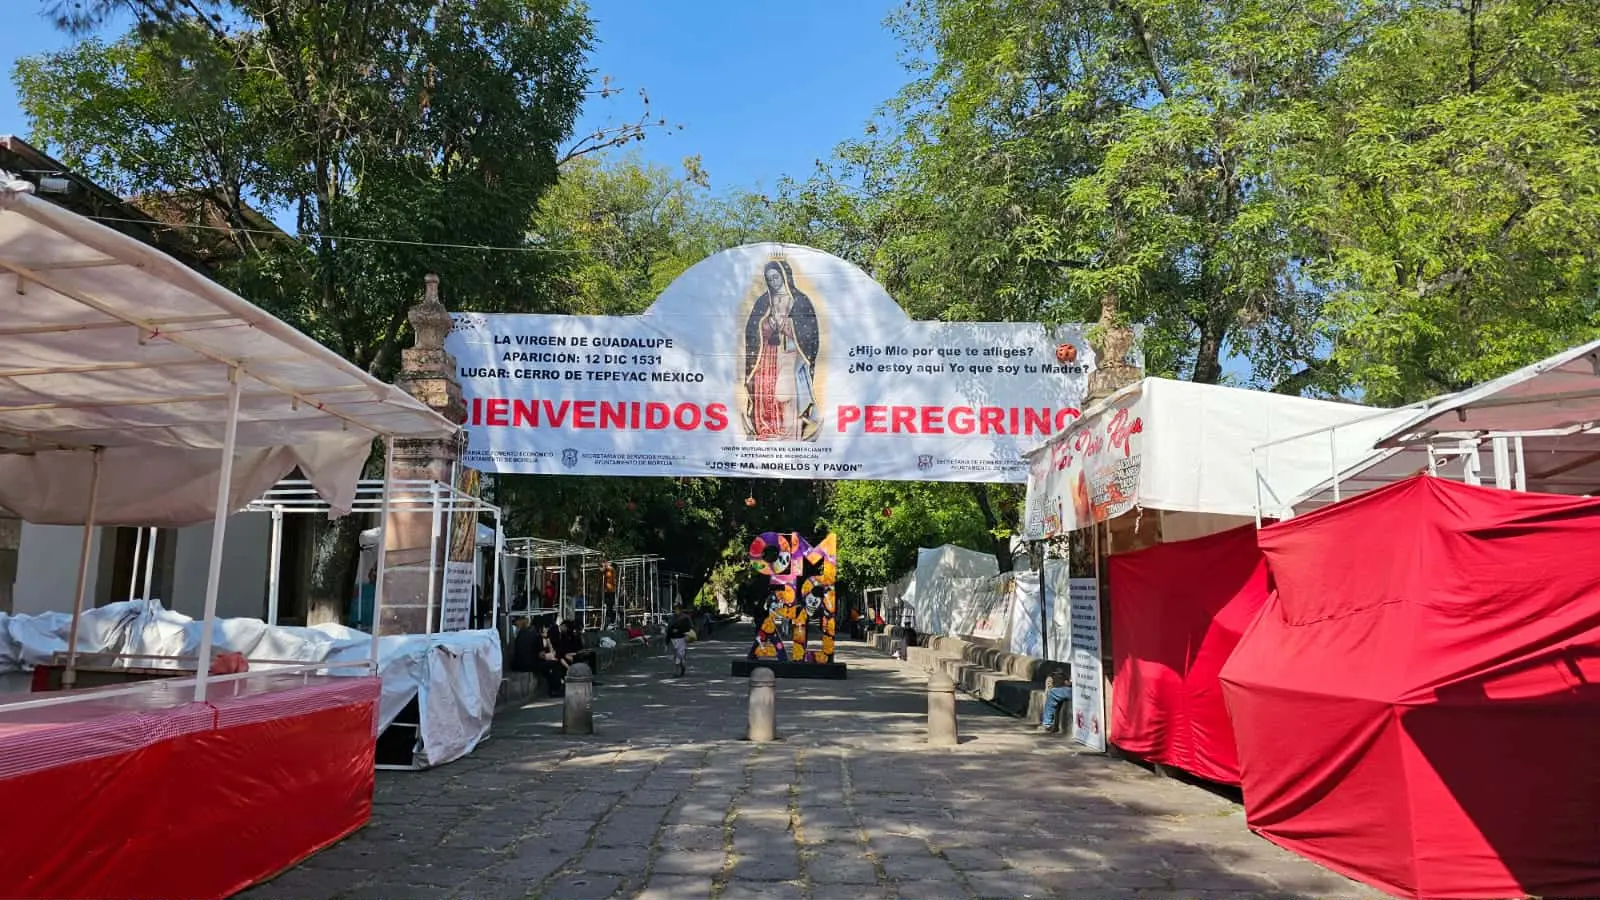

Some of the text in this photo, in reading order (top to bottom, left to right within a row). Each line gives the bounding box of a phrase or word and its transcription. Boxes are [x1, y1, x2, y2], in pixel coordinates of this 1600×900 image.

[494, 335, 673, 349] LA VIRGEN DE GUADALUPE
[912, 347, 934, 358] por
[937, 348, 962, 358] que
[965, 346, 979, 357] te
[982, 346, 1033, 358] afliges?
[585, 354, 601, 365] 12
[604, 354, 627, 365] DIC
[631, 355, 662, 366] 1531
[460, 367, 511, 379] LUGAR:
[514, 368, 560, 380] CERRO
[564, 370, 582, 381] DE
[587, 370, 647, 382] TEPEYAC
[848, 362, 874, 374] ¿No
[876, 364, 912, 375] estoy
[949, 364, 967, 374] Yo
[969, 365, 993, 375] que
[996, 365, 1020, 376] soy
[1023, 364, 1037, 374] tu
[1041, 364, 1090, 375] Madre?
[761, 462, 811, 471] MORELOS
[814, 463, 821, 471] Y
